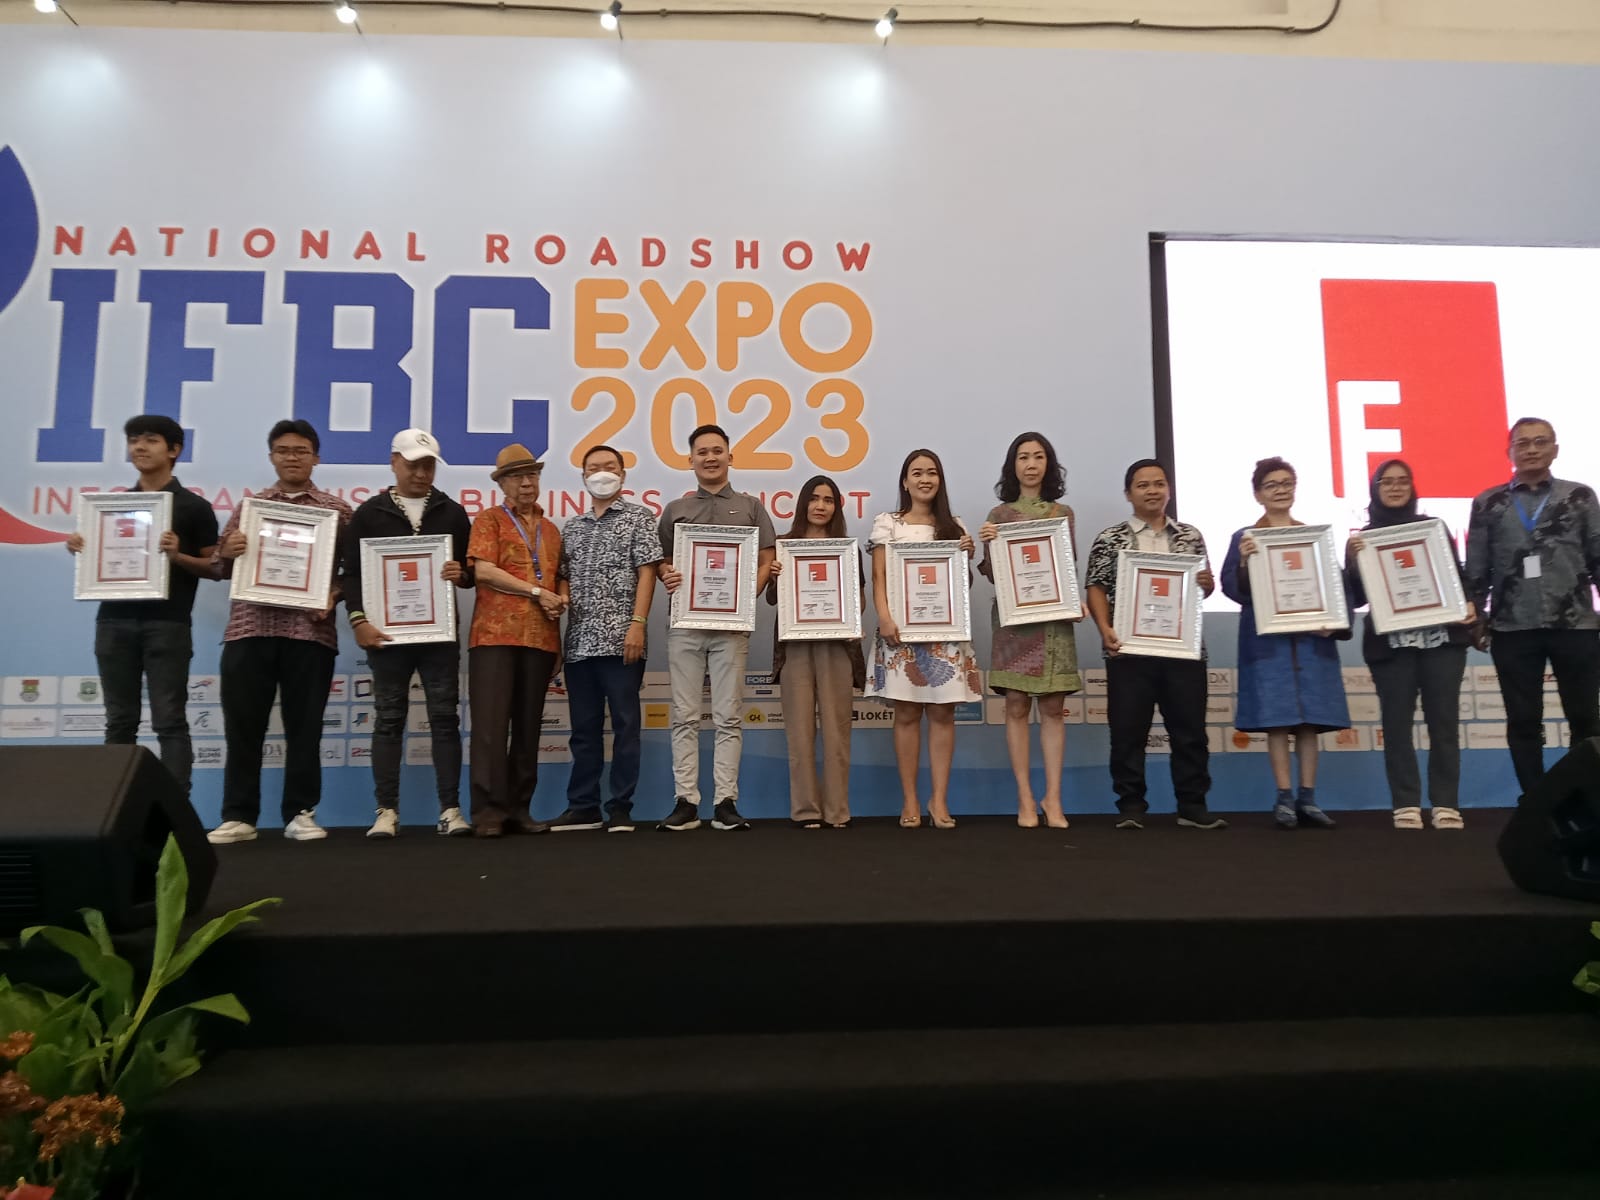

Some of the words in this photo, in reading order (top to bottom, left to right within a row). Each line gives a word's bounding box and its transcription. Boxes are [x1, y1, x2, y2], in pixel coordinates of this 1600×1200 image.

[54, 226, 425, 261] NATIONAL
[486, 233, 871, 272] ROADSHOW
[36, 268, 551, 465] IFBC
[574, 278, 873, 373] EXPO
[570, 376, 870, 472] 2023
